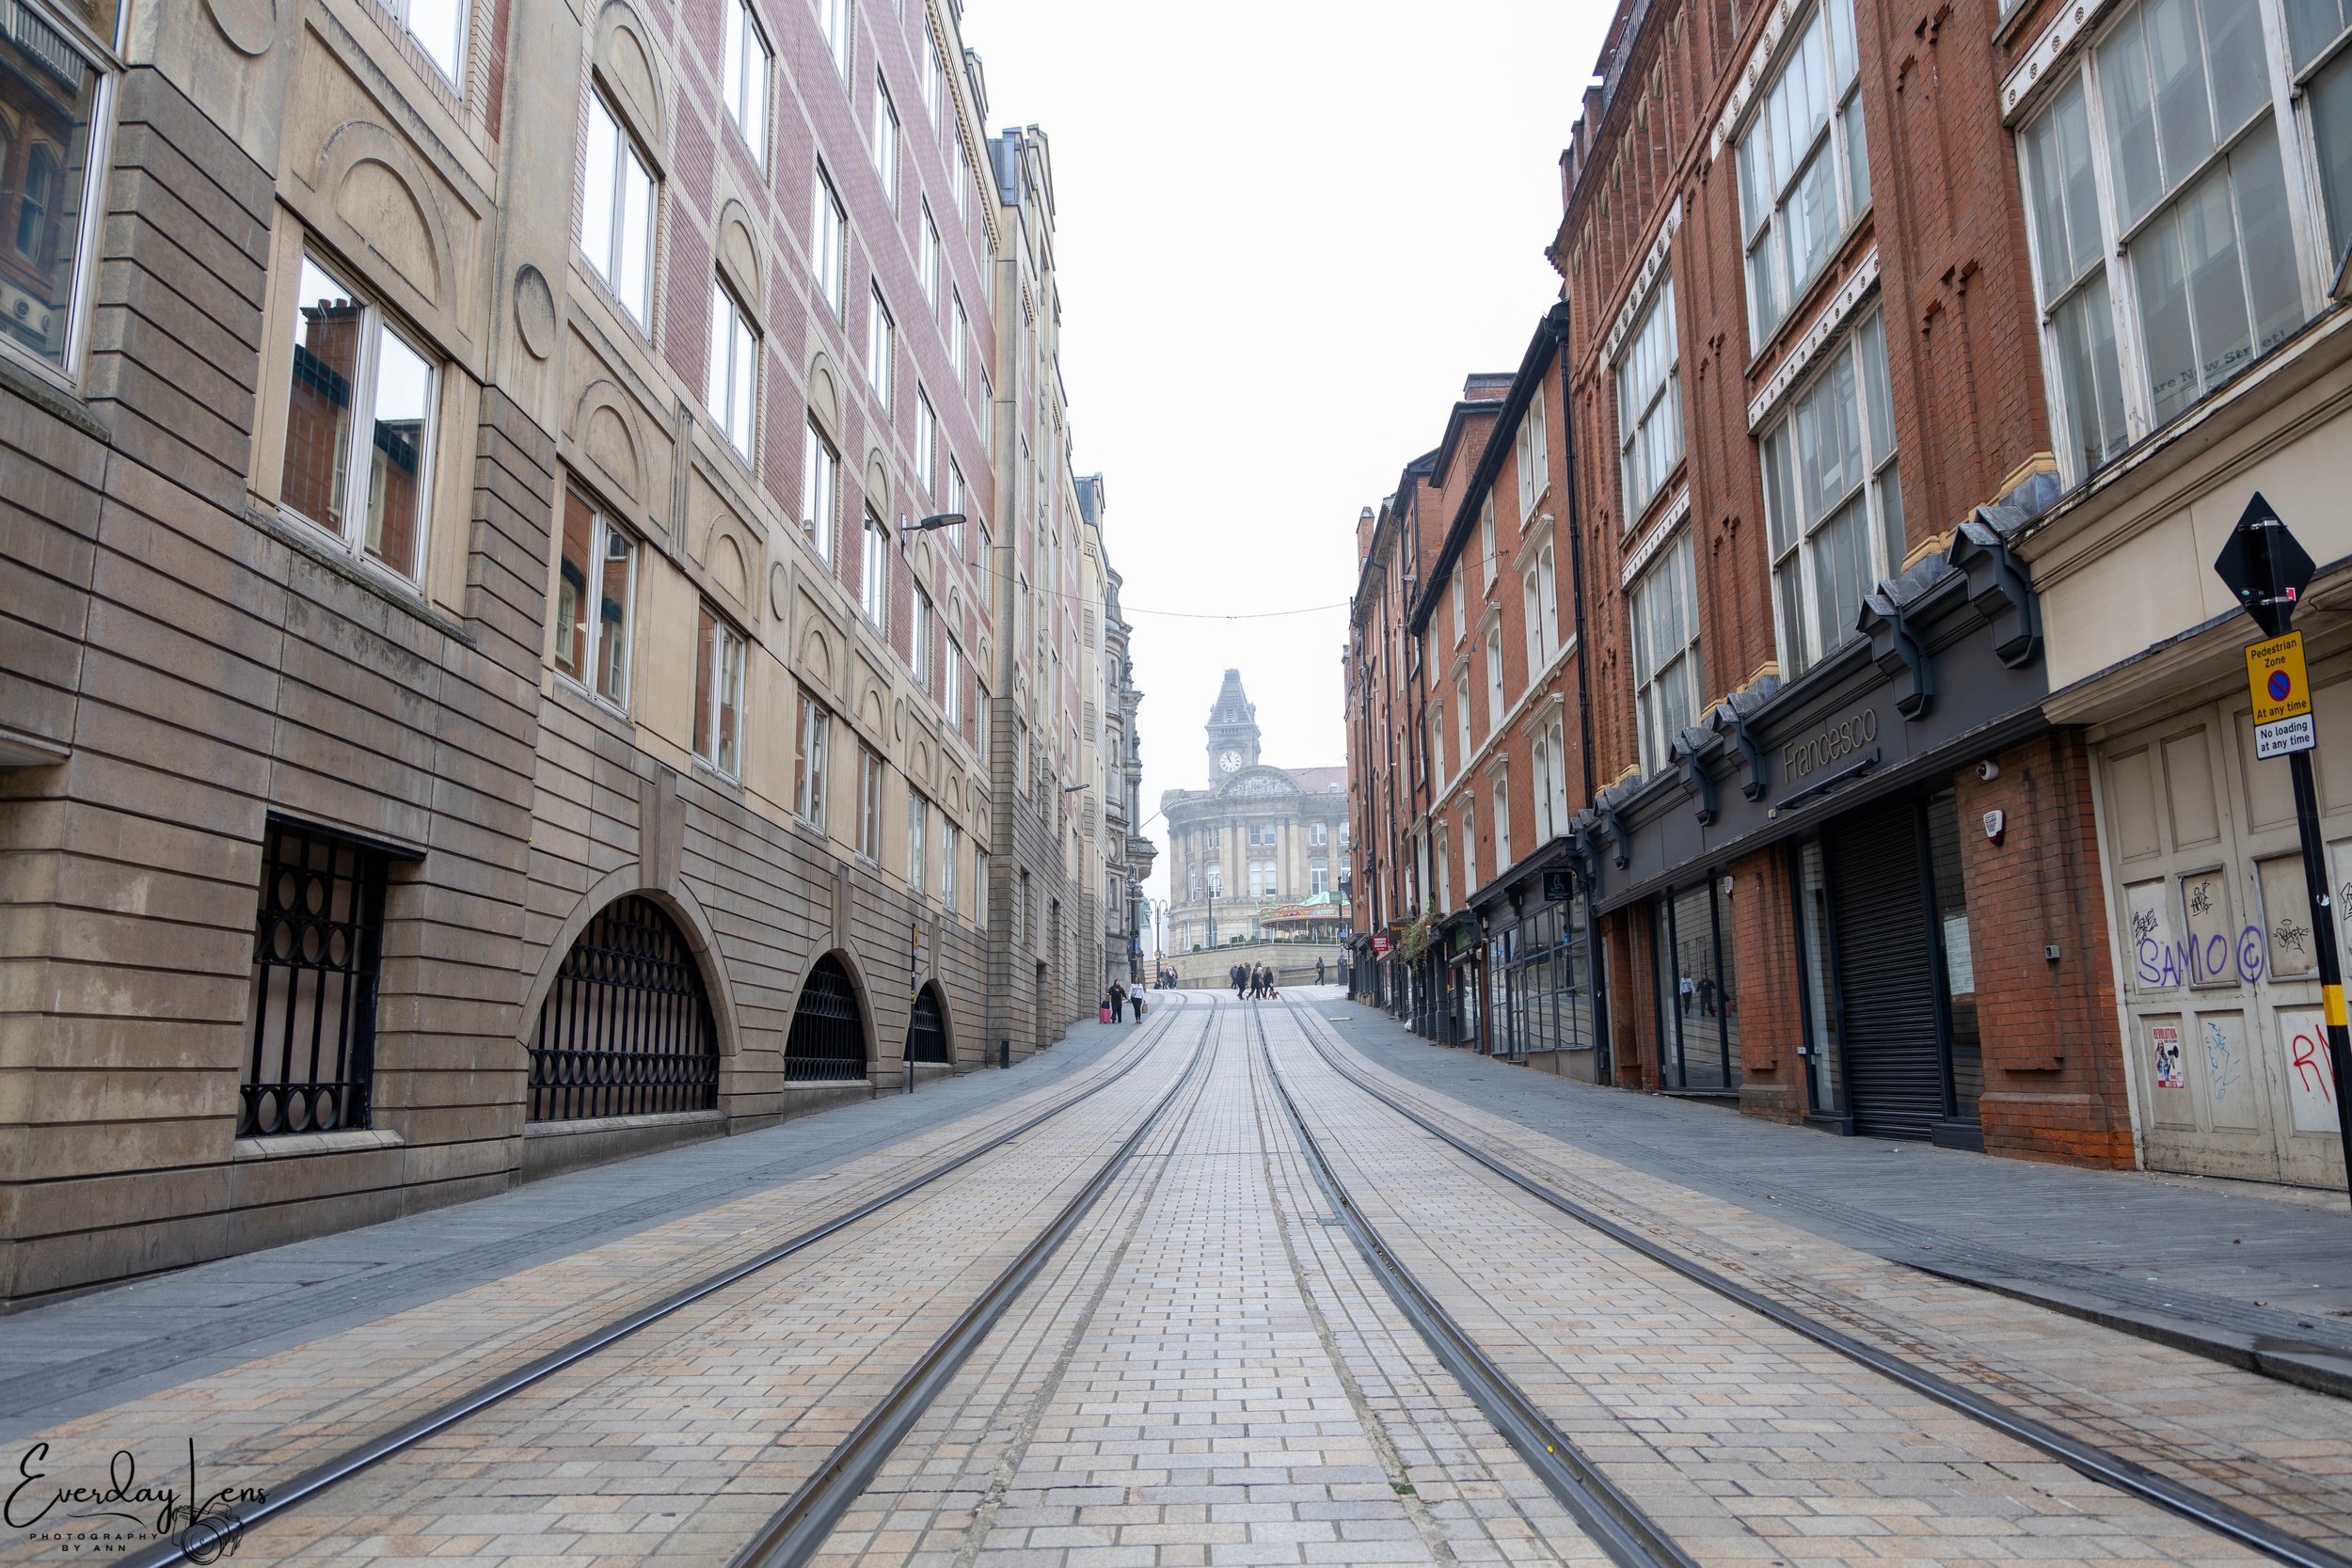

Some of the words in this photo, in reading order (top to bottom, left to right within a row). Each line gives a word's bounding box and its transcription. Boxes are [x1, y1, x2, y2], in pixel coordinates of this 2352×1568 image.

[2180, 360, 2219, 382] Nw
[2224, 329, 2285, 364] Stret!
[2251, 640, 2296, 659] Pedestrian
[2265, 656, 2285, 668] Zone
[2257, 709, 2266, 720] At
[2269, 705, 2284, 716] any
[2287, 700, 2307, 711] time
[2261, 729, 2273, 739] No
[2275, 721, 2307, 736] loading
[1782, 708, 1876, 784] Francesco
[2261, 742, 2269, 752] at
[2272, 739, 2287, 750] any
[2290, 734, 2310, 745] time
[2153, 1028, 2178, 1039] REVOLUTION
